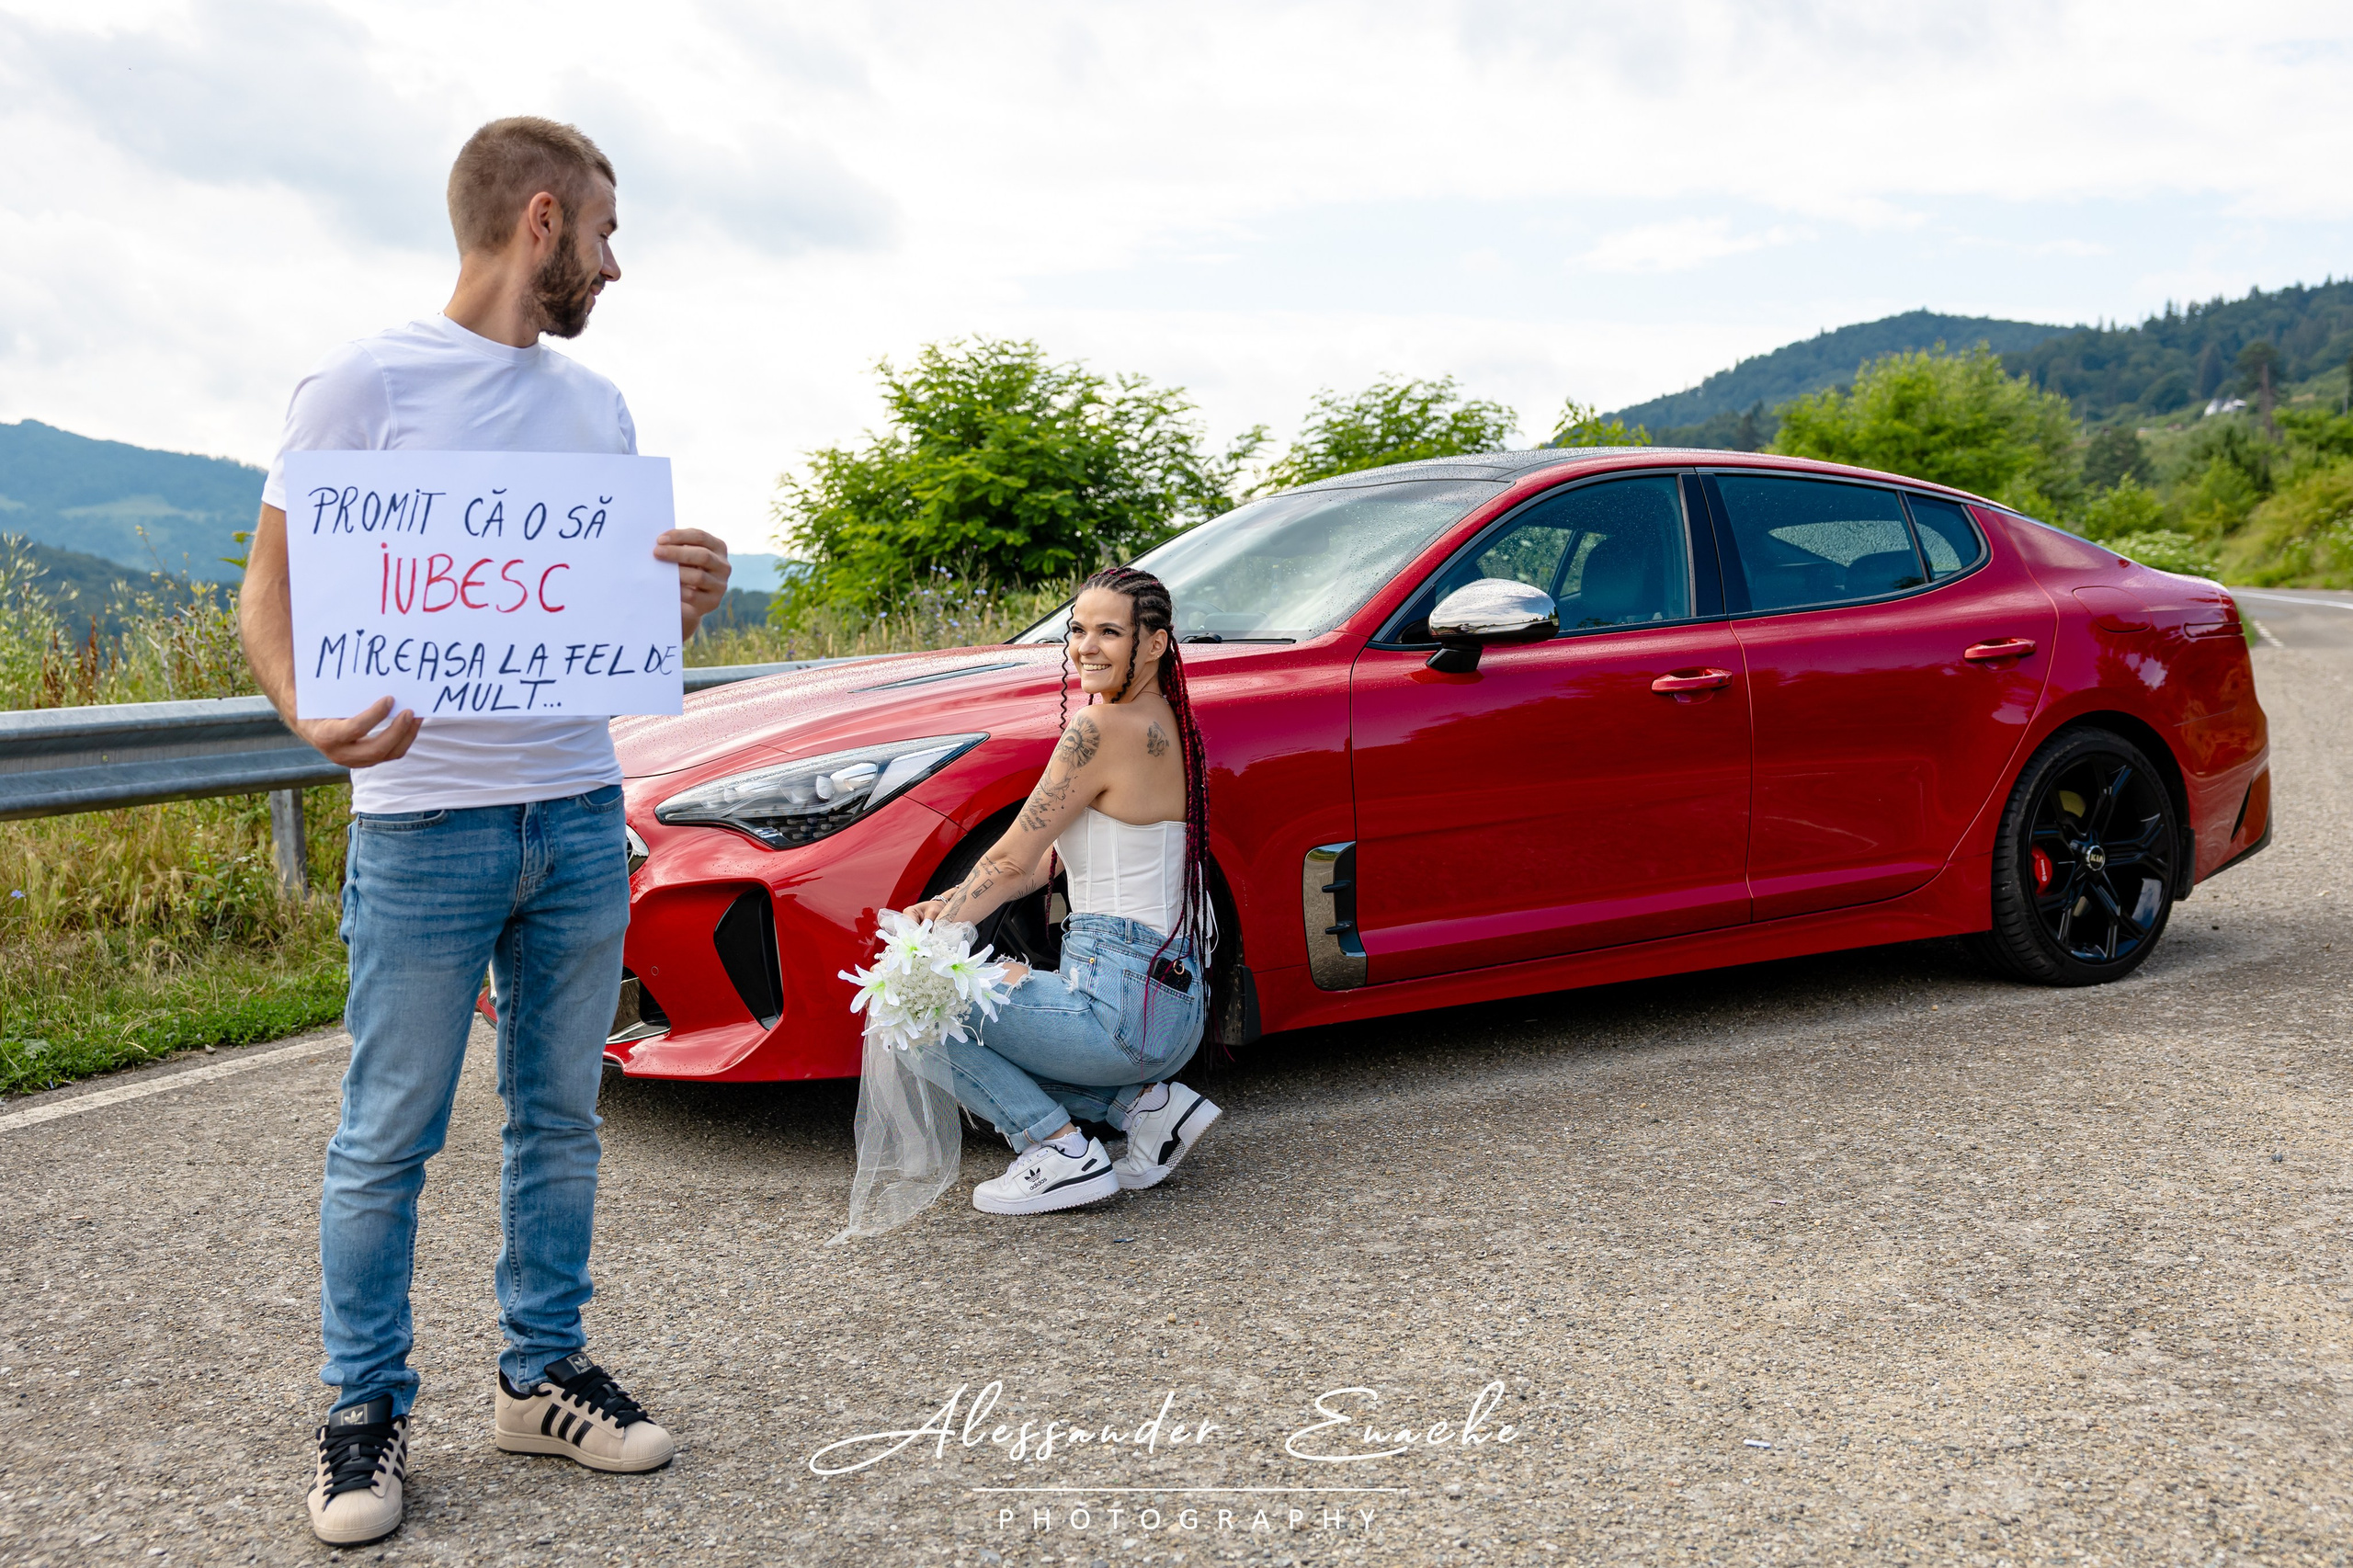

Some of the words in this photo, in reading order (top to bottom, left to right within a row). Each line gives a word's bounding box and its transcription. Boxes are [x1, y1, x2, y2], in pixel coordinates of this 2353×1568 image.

[309, 487, 447, 535] PROMIT
[464, 488, 507, 539] CĂ
[524, 503, 547, 540] O
[559, 495, 613, 540] SĂ
[381, 542, 570, 615] IUBESC
[316, 630, 486, 682] MIREASA
[498, 643, 550, 678] LA
[565, 644, 636, 676] FEL
[644, 644, 677, 676] DE
[2090, 854, 2104, 863] KIA
[1029, 1177, 1048, 1191] adidas
